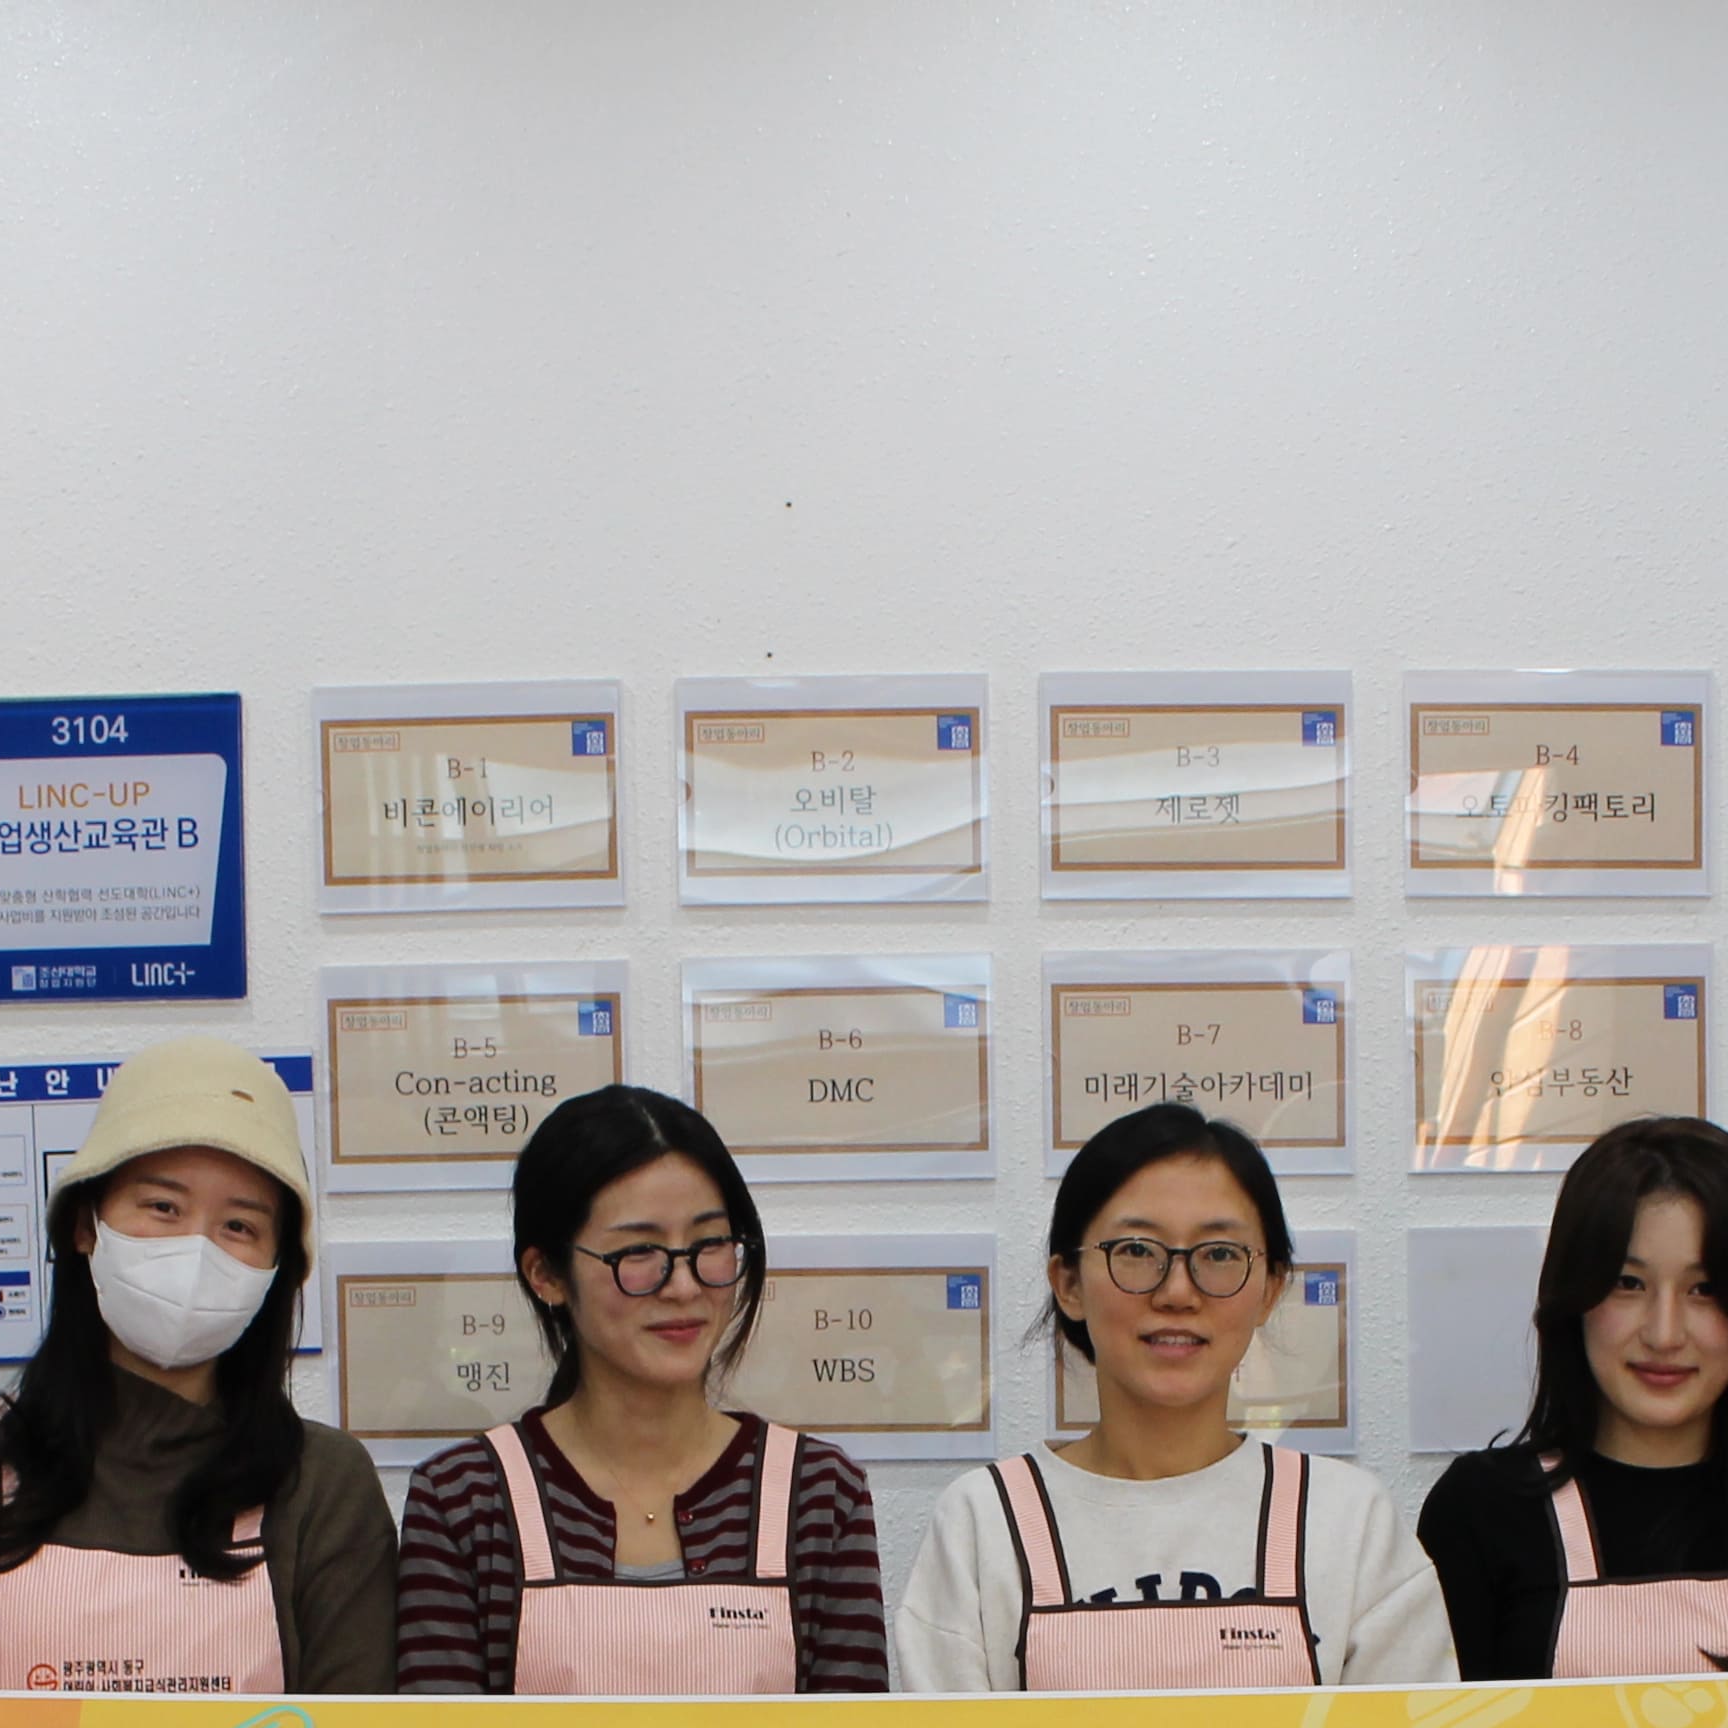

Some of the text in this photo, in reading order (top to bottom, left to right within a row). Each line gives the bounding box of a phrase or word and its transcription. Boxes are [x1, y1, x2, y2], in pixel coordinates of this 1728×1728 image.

[52, 714, 128, 745] 3104
[447, 757, 489, 779] B-1
[810, 750, 855, 773] B-2
[1176, 746, 1221, 768] B-3
[1536, 744, 1580, 766] B-4
[19, 782, 151, 809] LINC-UP
[789, 785, 877, 816] 오비탈
[384, 794, 555, 828] 비콘에이리어
[1154, 794, 1241, 825] 제로젯
[177, 817, 199, 848] B
[774, 823, 894, 852] (Orbital)
[42, 888, 93, 903] 산학협력
[141, 905, 201, 920] 공간입니다
[818, 1029, 863, 1051] B-6
[1177, 1023, 1222, 1046] B-7
[453, 1037, 497, 1059] B-5
[394, 1069, 558, 1098] Con-acting
[807, 1078, 875, 1104] DMC
[1084, 1070, 1313, 1103] 미래기술아카데미
[424, 1104, 529, 1136] (콘액팅)
[461, 1314, 506, 1337] B-9
[814, 1308, 873, 1332] B-10
[456, 1361, 511, 1393] 맹진
[812, 1358, 876, 1384] WBS
